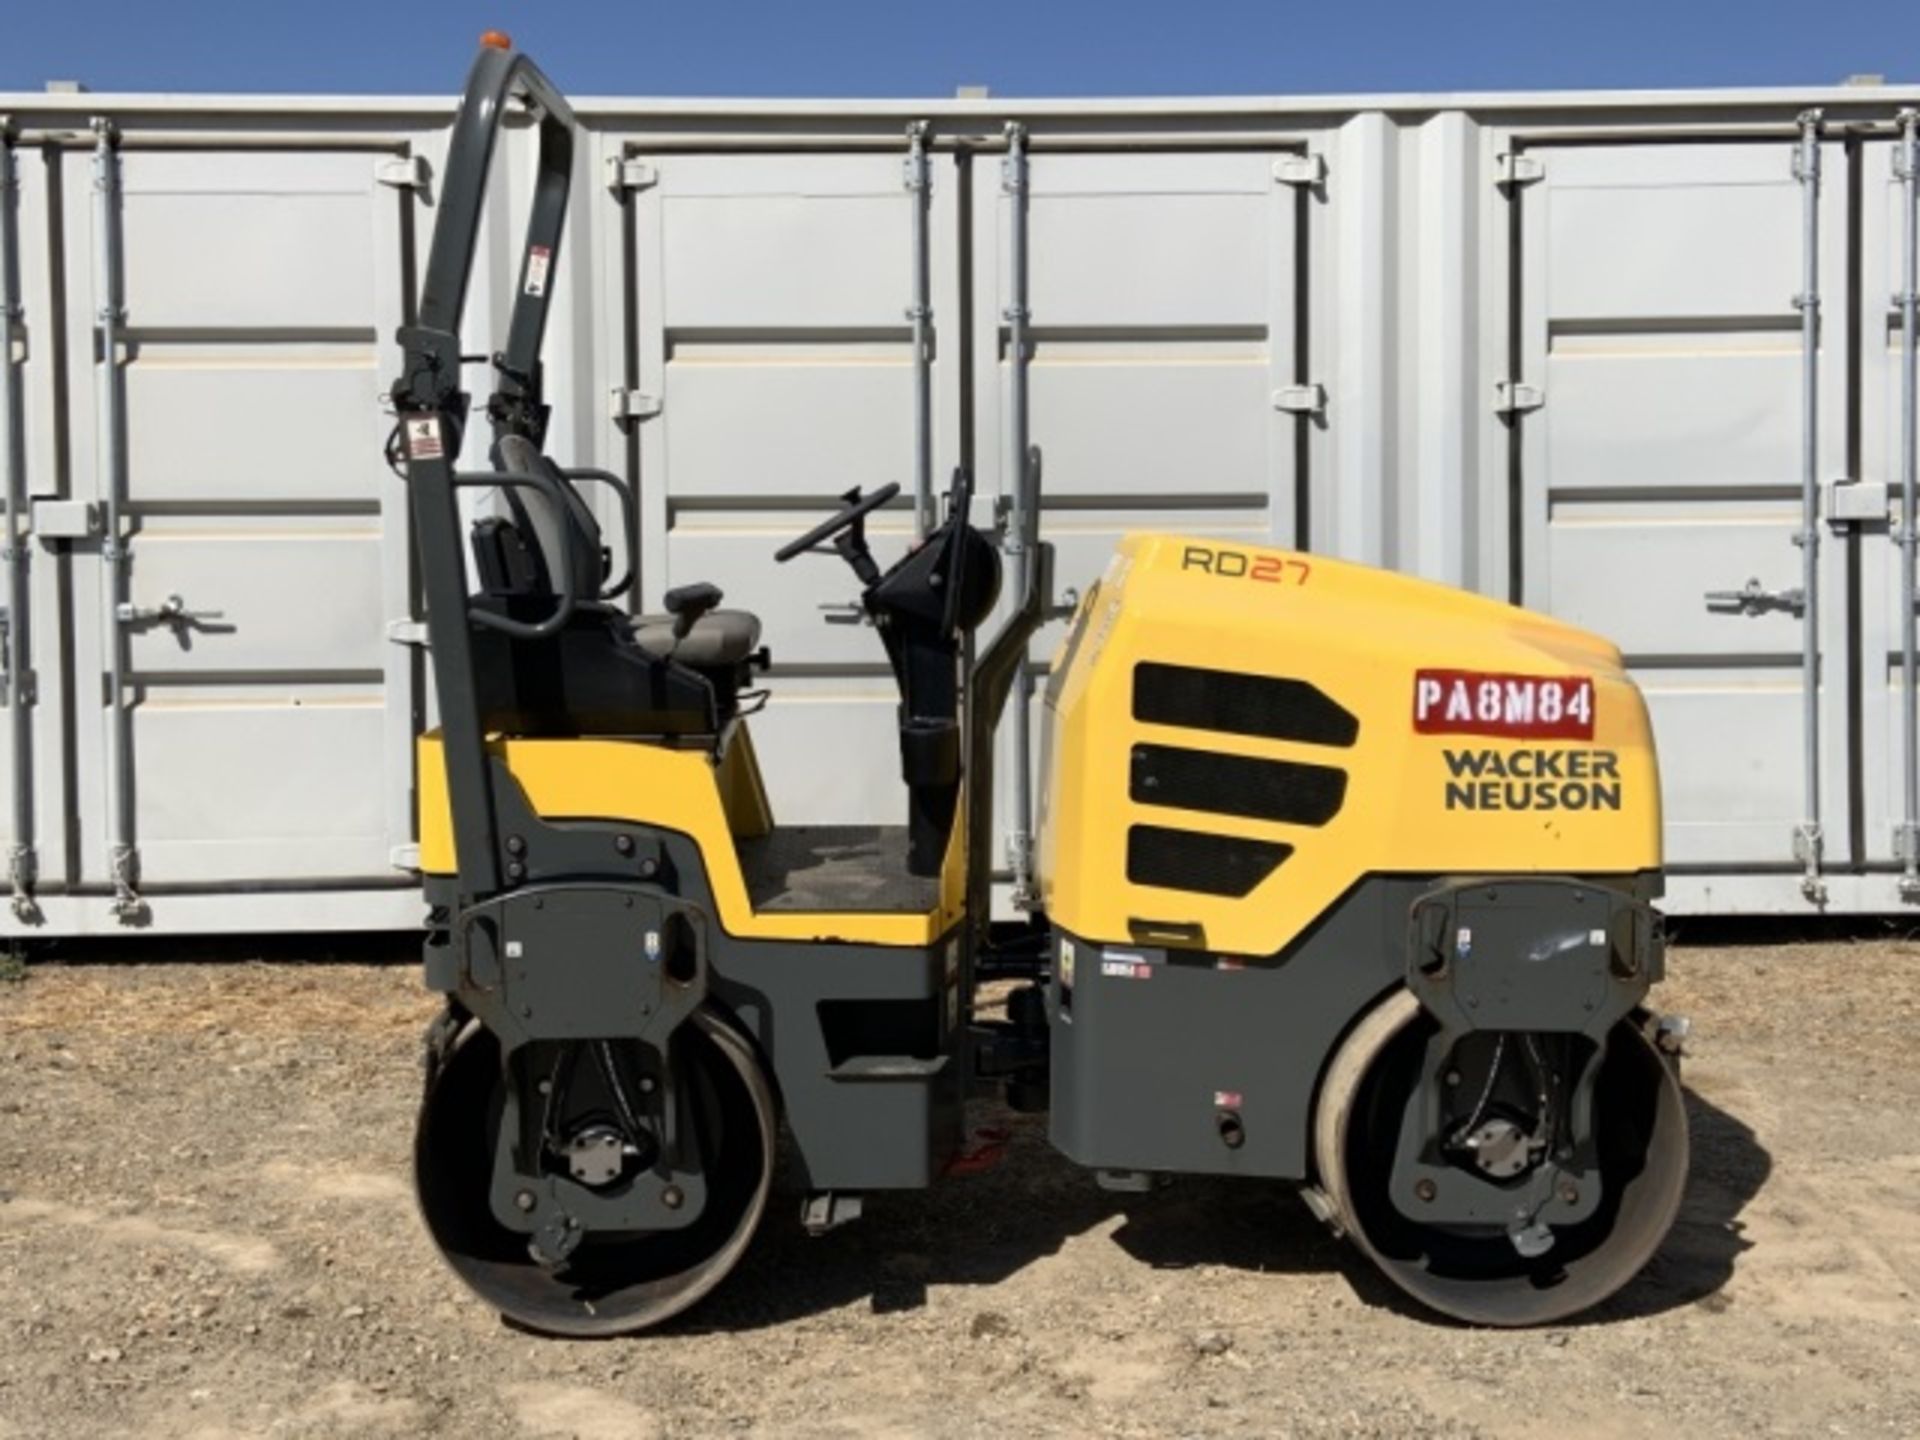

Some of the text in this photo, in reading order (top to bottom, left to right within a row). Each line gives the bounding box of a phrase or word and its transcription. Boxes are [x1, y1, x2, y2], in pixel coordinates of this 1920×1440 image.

[1182, 547, 1311, 586] RD27
[1416, 678, 1591, 725] PA8M84
[1443, 750, 1621, 779] WACKER
[1446, 782, 1621, 811] NEUSON
